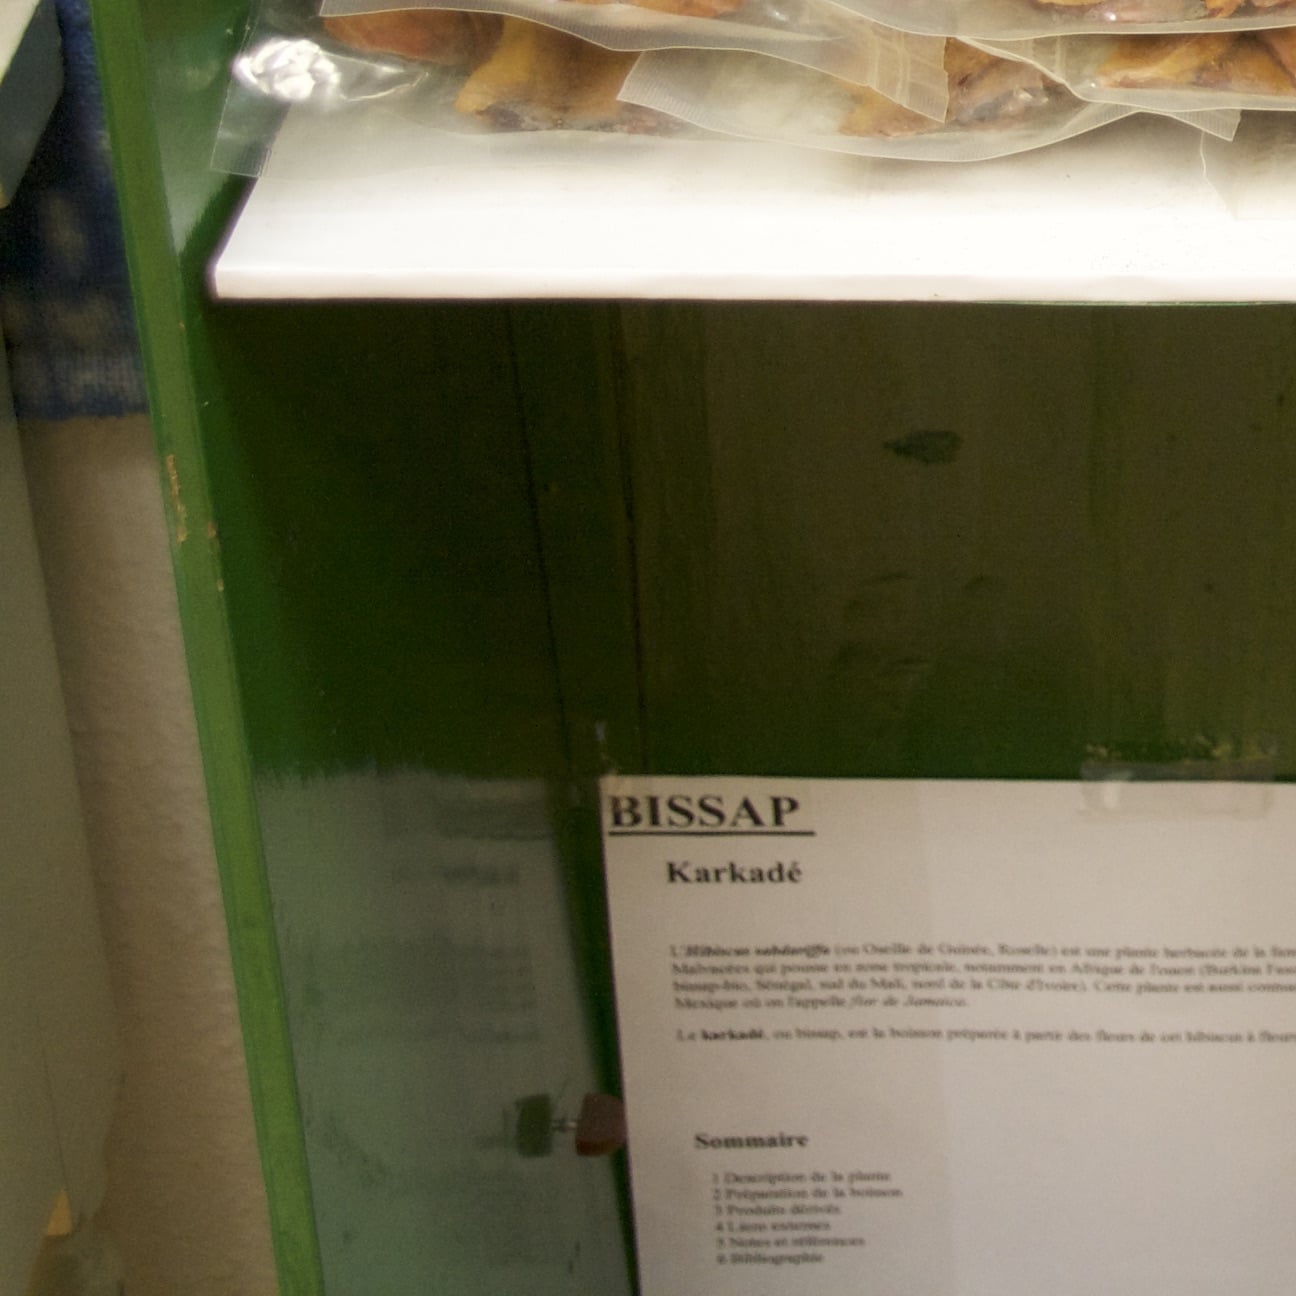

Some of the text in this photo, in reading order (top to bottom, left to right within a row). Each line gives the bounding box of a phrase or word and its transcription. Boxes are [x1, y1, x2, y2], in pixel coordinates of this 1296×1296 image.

[609, 795, 800, 828] BISSAP
[666, 859, 803, 885] Karkadé
[694, 1133, 809, 1150] Sommaire
